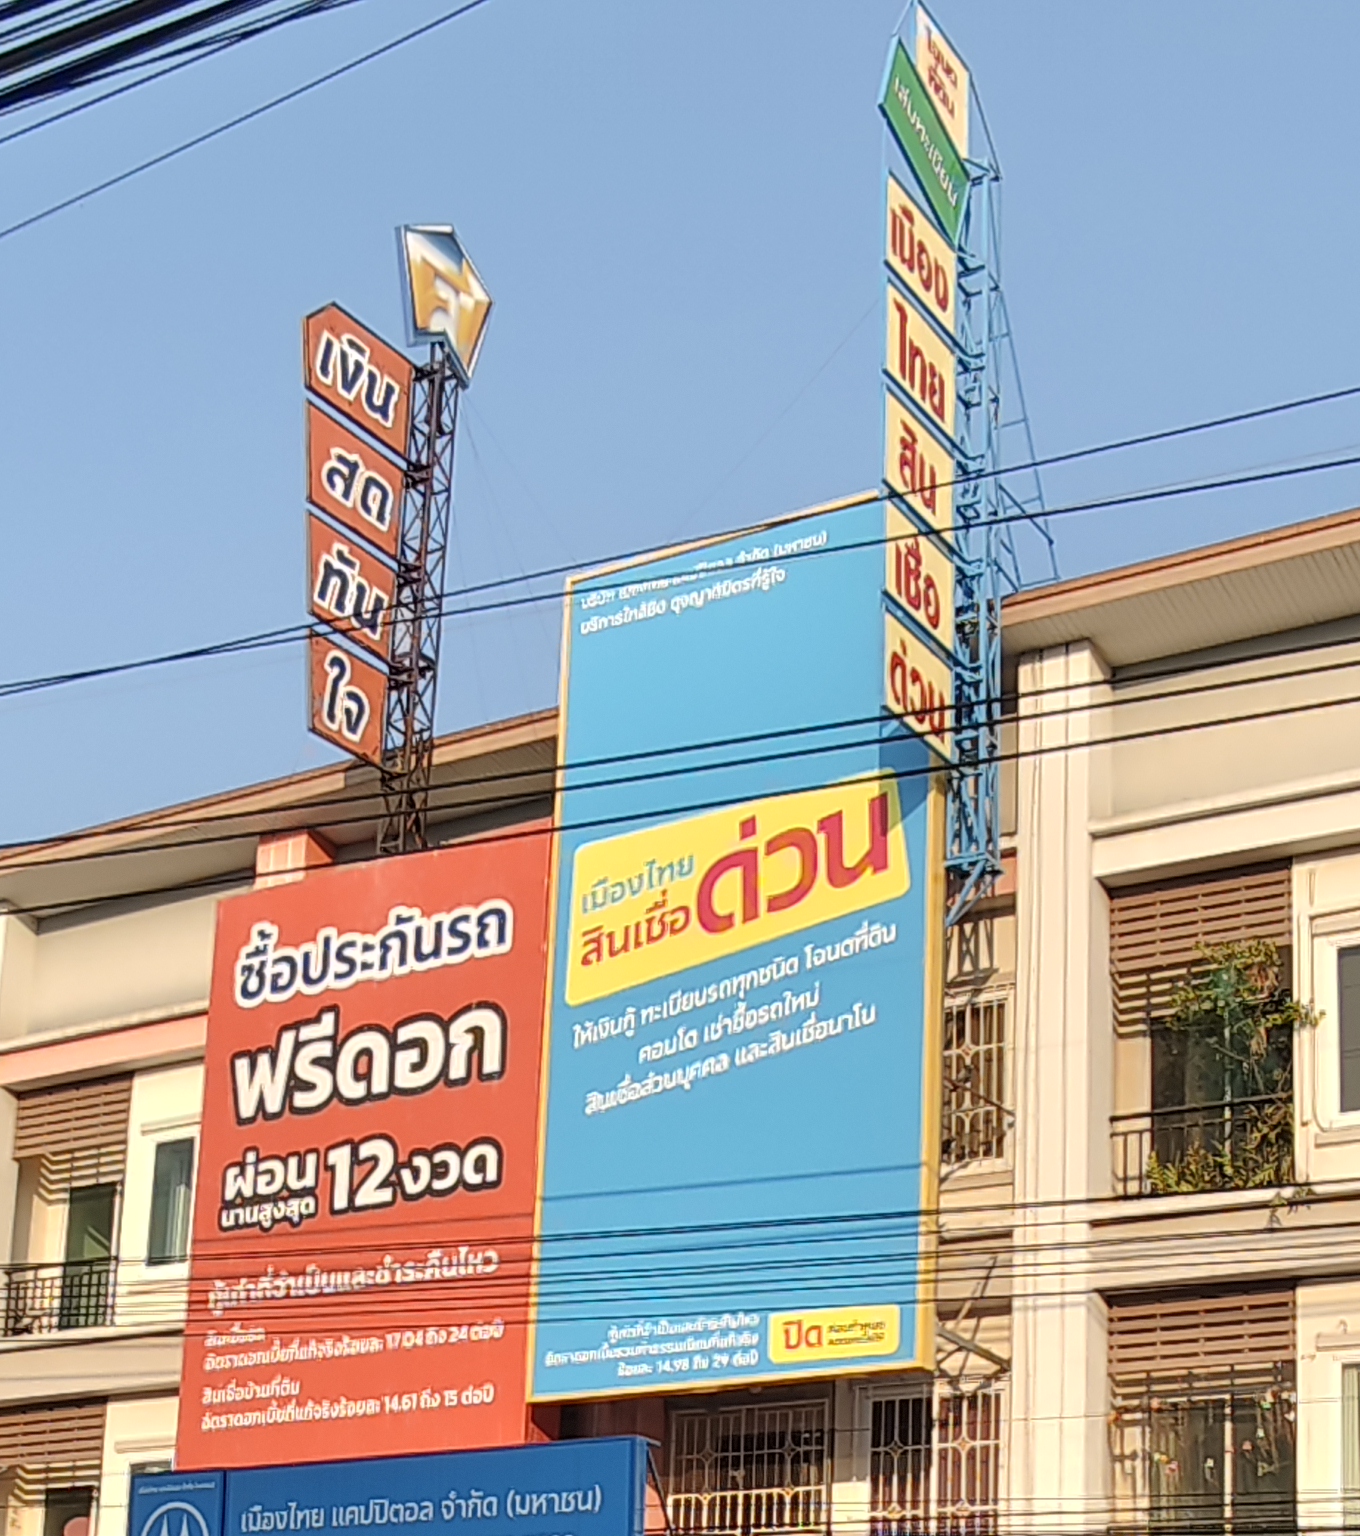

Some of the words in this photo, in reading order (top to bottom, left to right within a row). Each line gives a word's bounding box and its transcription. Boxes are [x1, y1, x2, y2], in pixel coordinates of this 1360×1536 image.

[890, 203, 949, 312] เมือง
[315, 329, 398, 428] เงิน
[322, 446, 393, 531] สด
[899, 418, 937, 516] สิน
[315, 543, 388, 639] ทัน
[324, 650, 370, 743] ใจ
[890, 636, 946, 745] ด่วน
[582, 855, 694, 914] เมืองไทย
[696, 791, 889, 935] ด่วน
[238, 902, 509, 1004] ซื้อประกันรถ
[580, 889, 691, 967] สินเชื่อ
[572, 1006, 637, 1049] ให้เงินกู้
[641, 955, 799, 1025] ทะเบียนรถทุกชนิด
[803, 920, 897, 970] โฉนดที่ดิน
[638, 1025, 699, 1063] คอนโด
[703, 980, 820, 1043] เช่าซื้อรถใหม่
[233, 1005, 504, 1122] ฟรีดอก
[585, 1052, 731, 1115] สินเชื่อส่วนบุคคล
[734, 1003, 877, 1067] และสินเชื่อนาโน
[221, 1196, 316, 1228] นานสูงสุด
[225, 1150, 318, 1203] ผ่อน
[328, 1137, 395, 1211] 12
[399, 1143, 500, 1195] งวด
[448, 1325, 469, 1343] 24
[461, 1382, 495, 1405] ต่อปี
[241, 1502, 324, 1534] เมืองไทย
[332, 1497, 435, 1529] แคปปิตอล
[441, 1489, 498, 1524] จำกัด
[506, 1483, 602, 1519] (มหาชน)
